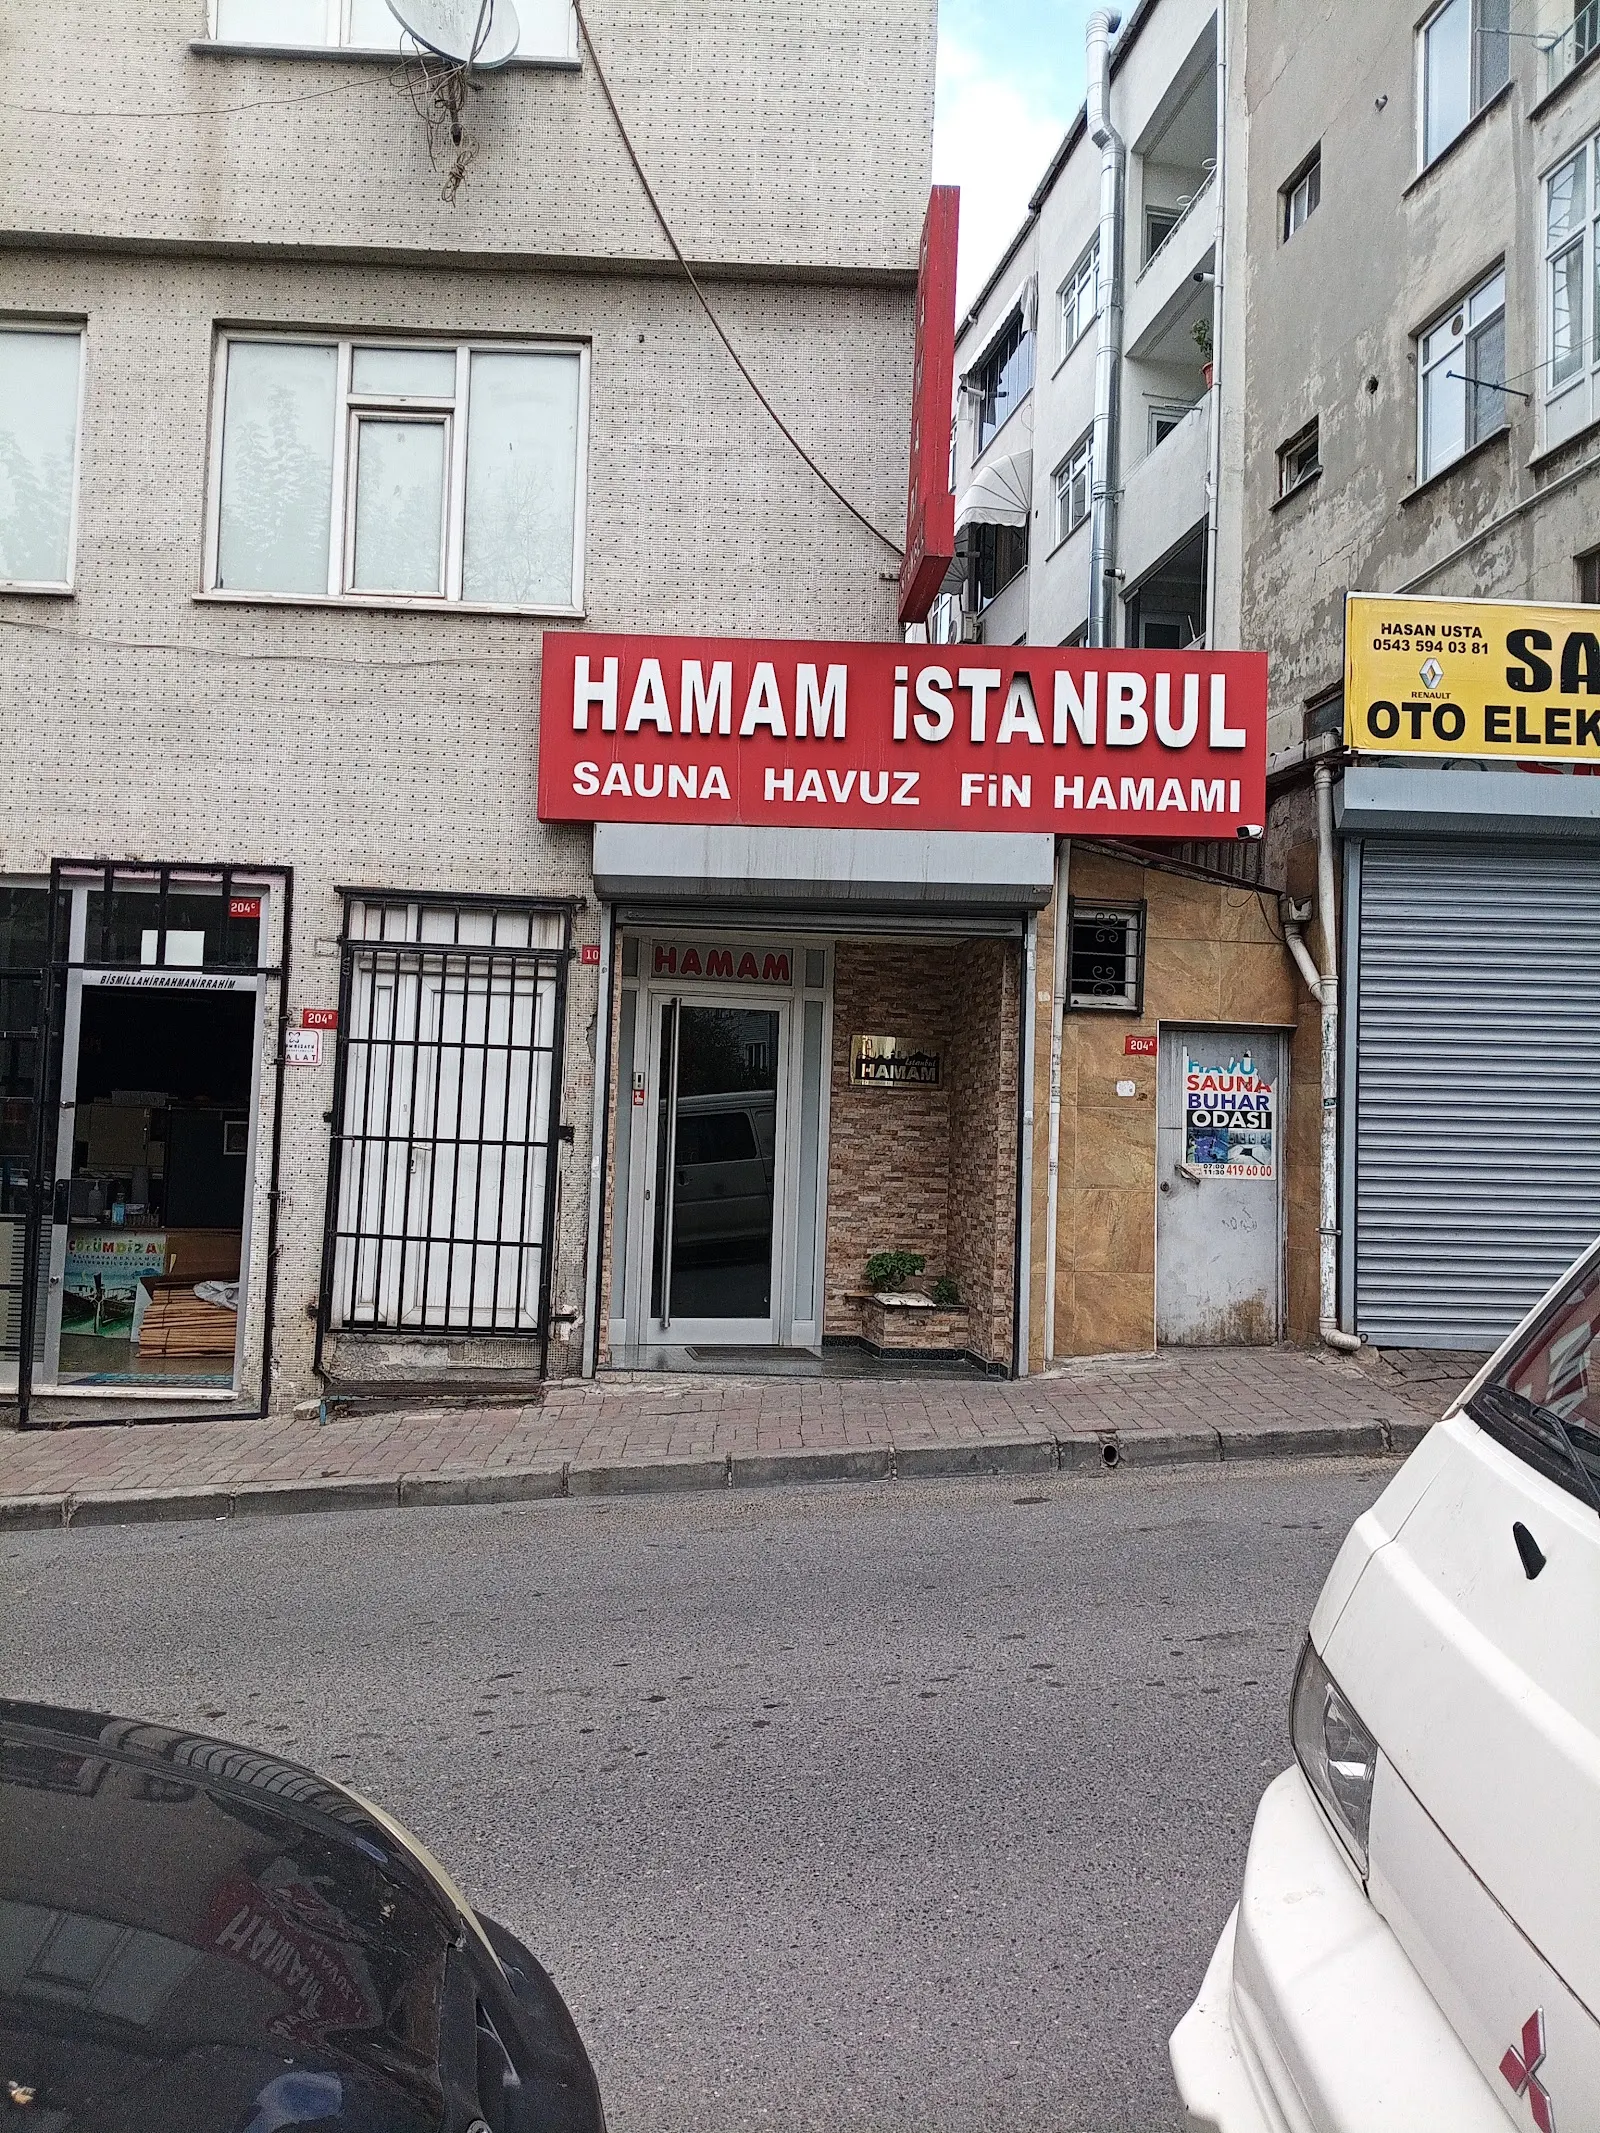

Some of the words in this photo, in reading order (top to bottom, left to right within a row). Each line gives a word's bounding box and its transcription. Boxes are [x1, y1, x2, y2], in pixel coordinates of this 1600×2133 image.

[1381, 623, 1436, 637] HASAN
[1441, 625, 1482, 638] USTA
[1373, 638, 1410, 652] 0543
[1415, 640, 1443, 653] 594
[1449, 641, 1466, 653] 03
[1471, 642, 1488, 655] 81
[572, 655, 848, 738] HAMAM
[1411, 691, 1451, 700] RENAULT
[1367, 700, 1466, 742] OTO
[1484, 705, 1600, 746] ELEK
[572, 761, 731, 800] SAUNA
[763, 767, 920, 806] HAVUZ
[1054, 775, 1242, 814] HAMAMI
[654, 946, 790, 981] HAMAM
[861, 1063, 936, 1081] HAMAM
[1187, 1074, 1272, 1093] SAUNA
[1188, 1093, 1269, 1111] BUHAR
[1192, 1110, 1267, 1128] ODASI
[1227, 1165, 1244, 1175] 419
[1246, 1165, 1258, 1176] 60
[1260, 1166, 1272, 1176] 00
